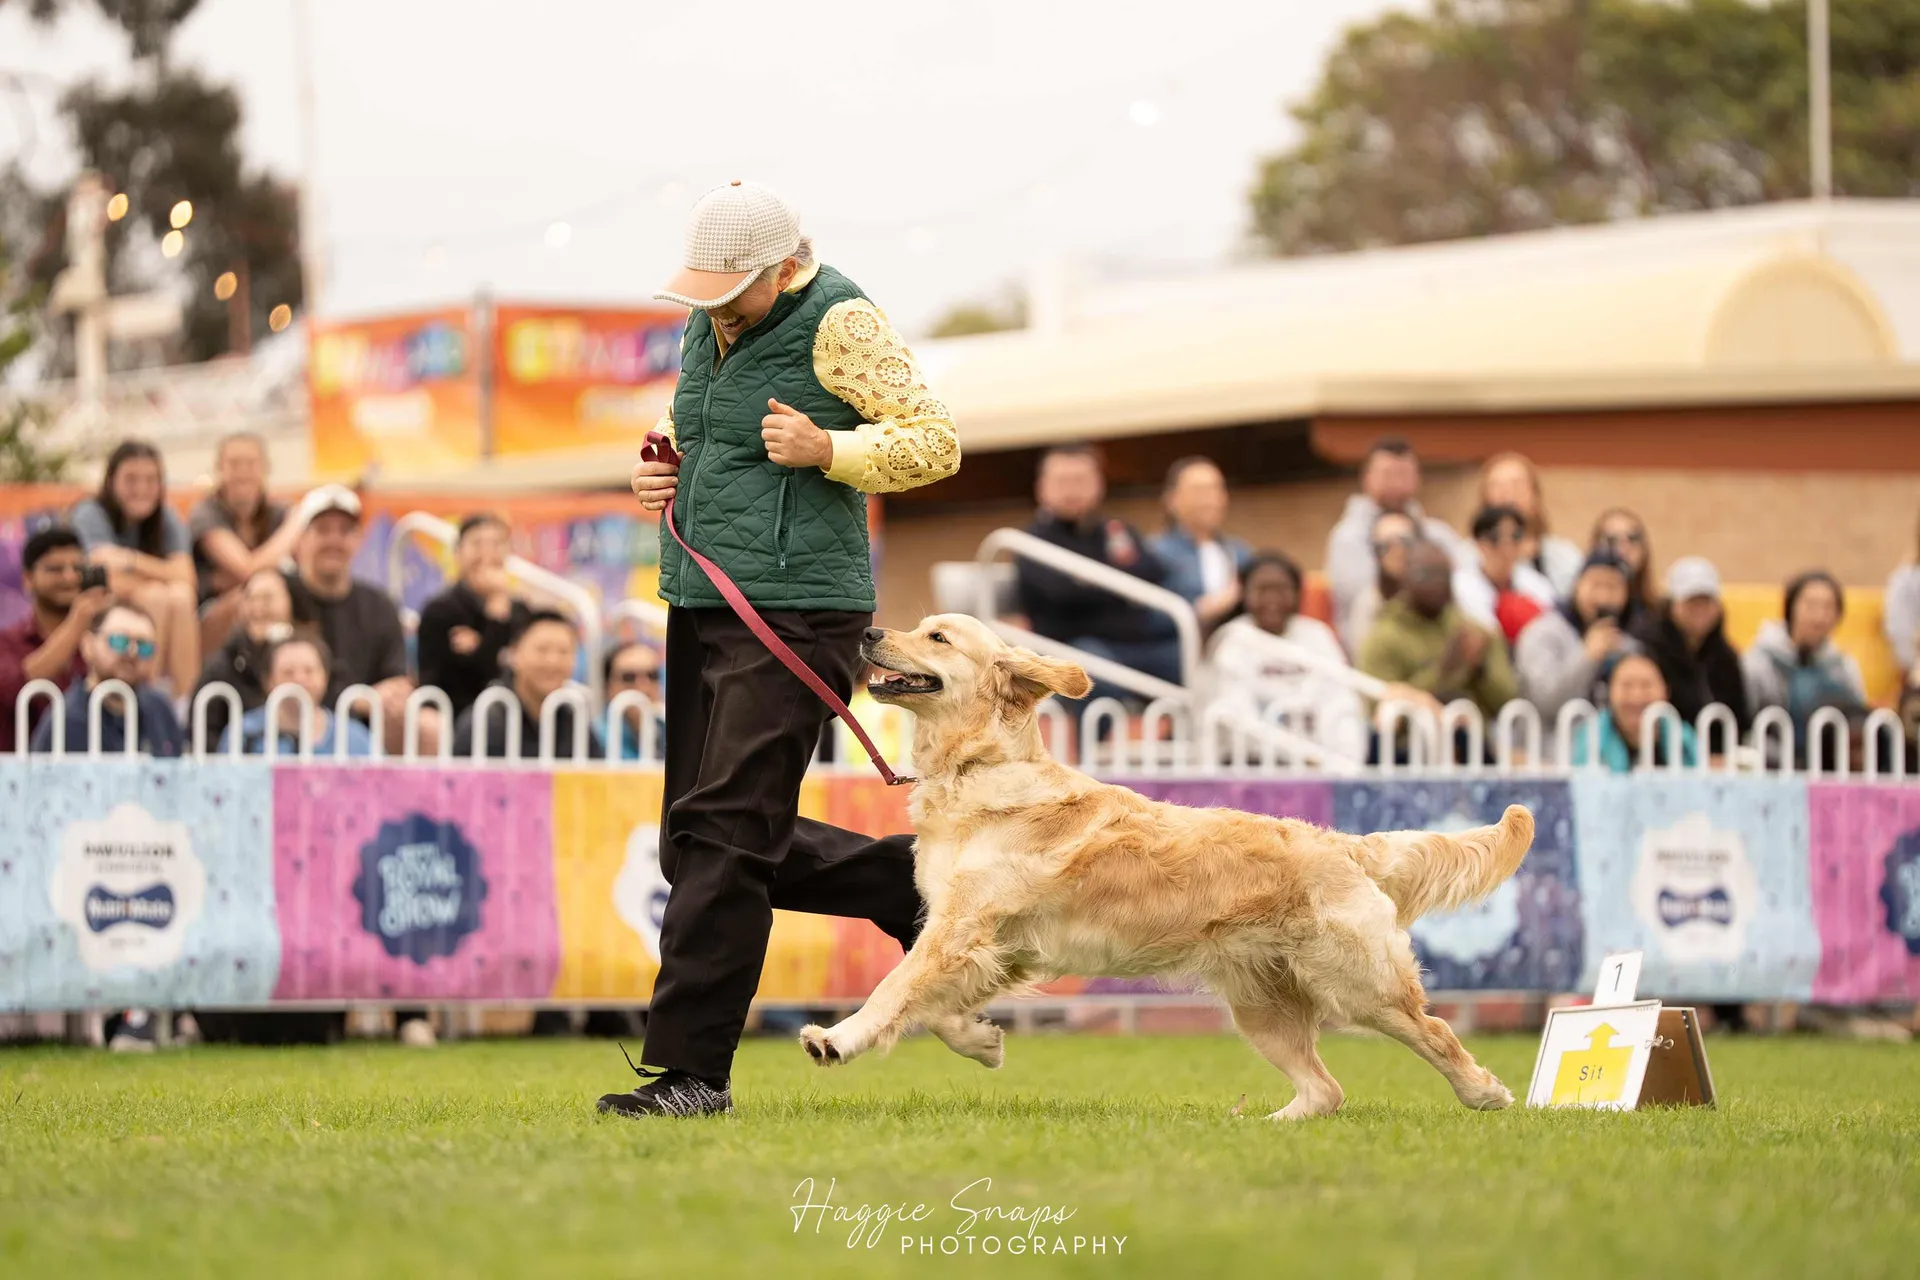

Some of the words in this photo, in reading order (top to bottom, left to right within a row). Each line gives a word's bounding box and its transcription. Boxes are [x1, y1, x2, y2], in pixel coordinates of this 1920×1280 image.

[723, 257, 737, 269] M
[1613, 962, 1624, 993] 1
[1578, 1065, 1604, 1082] Sit
